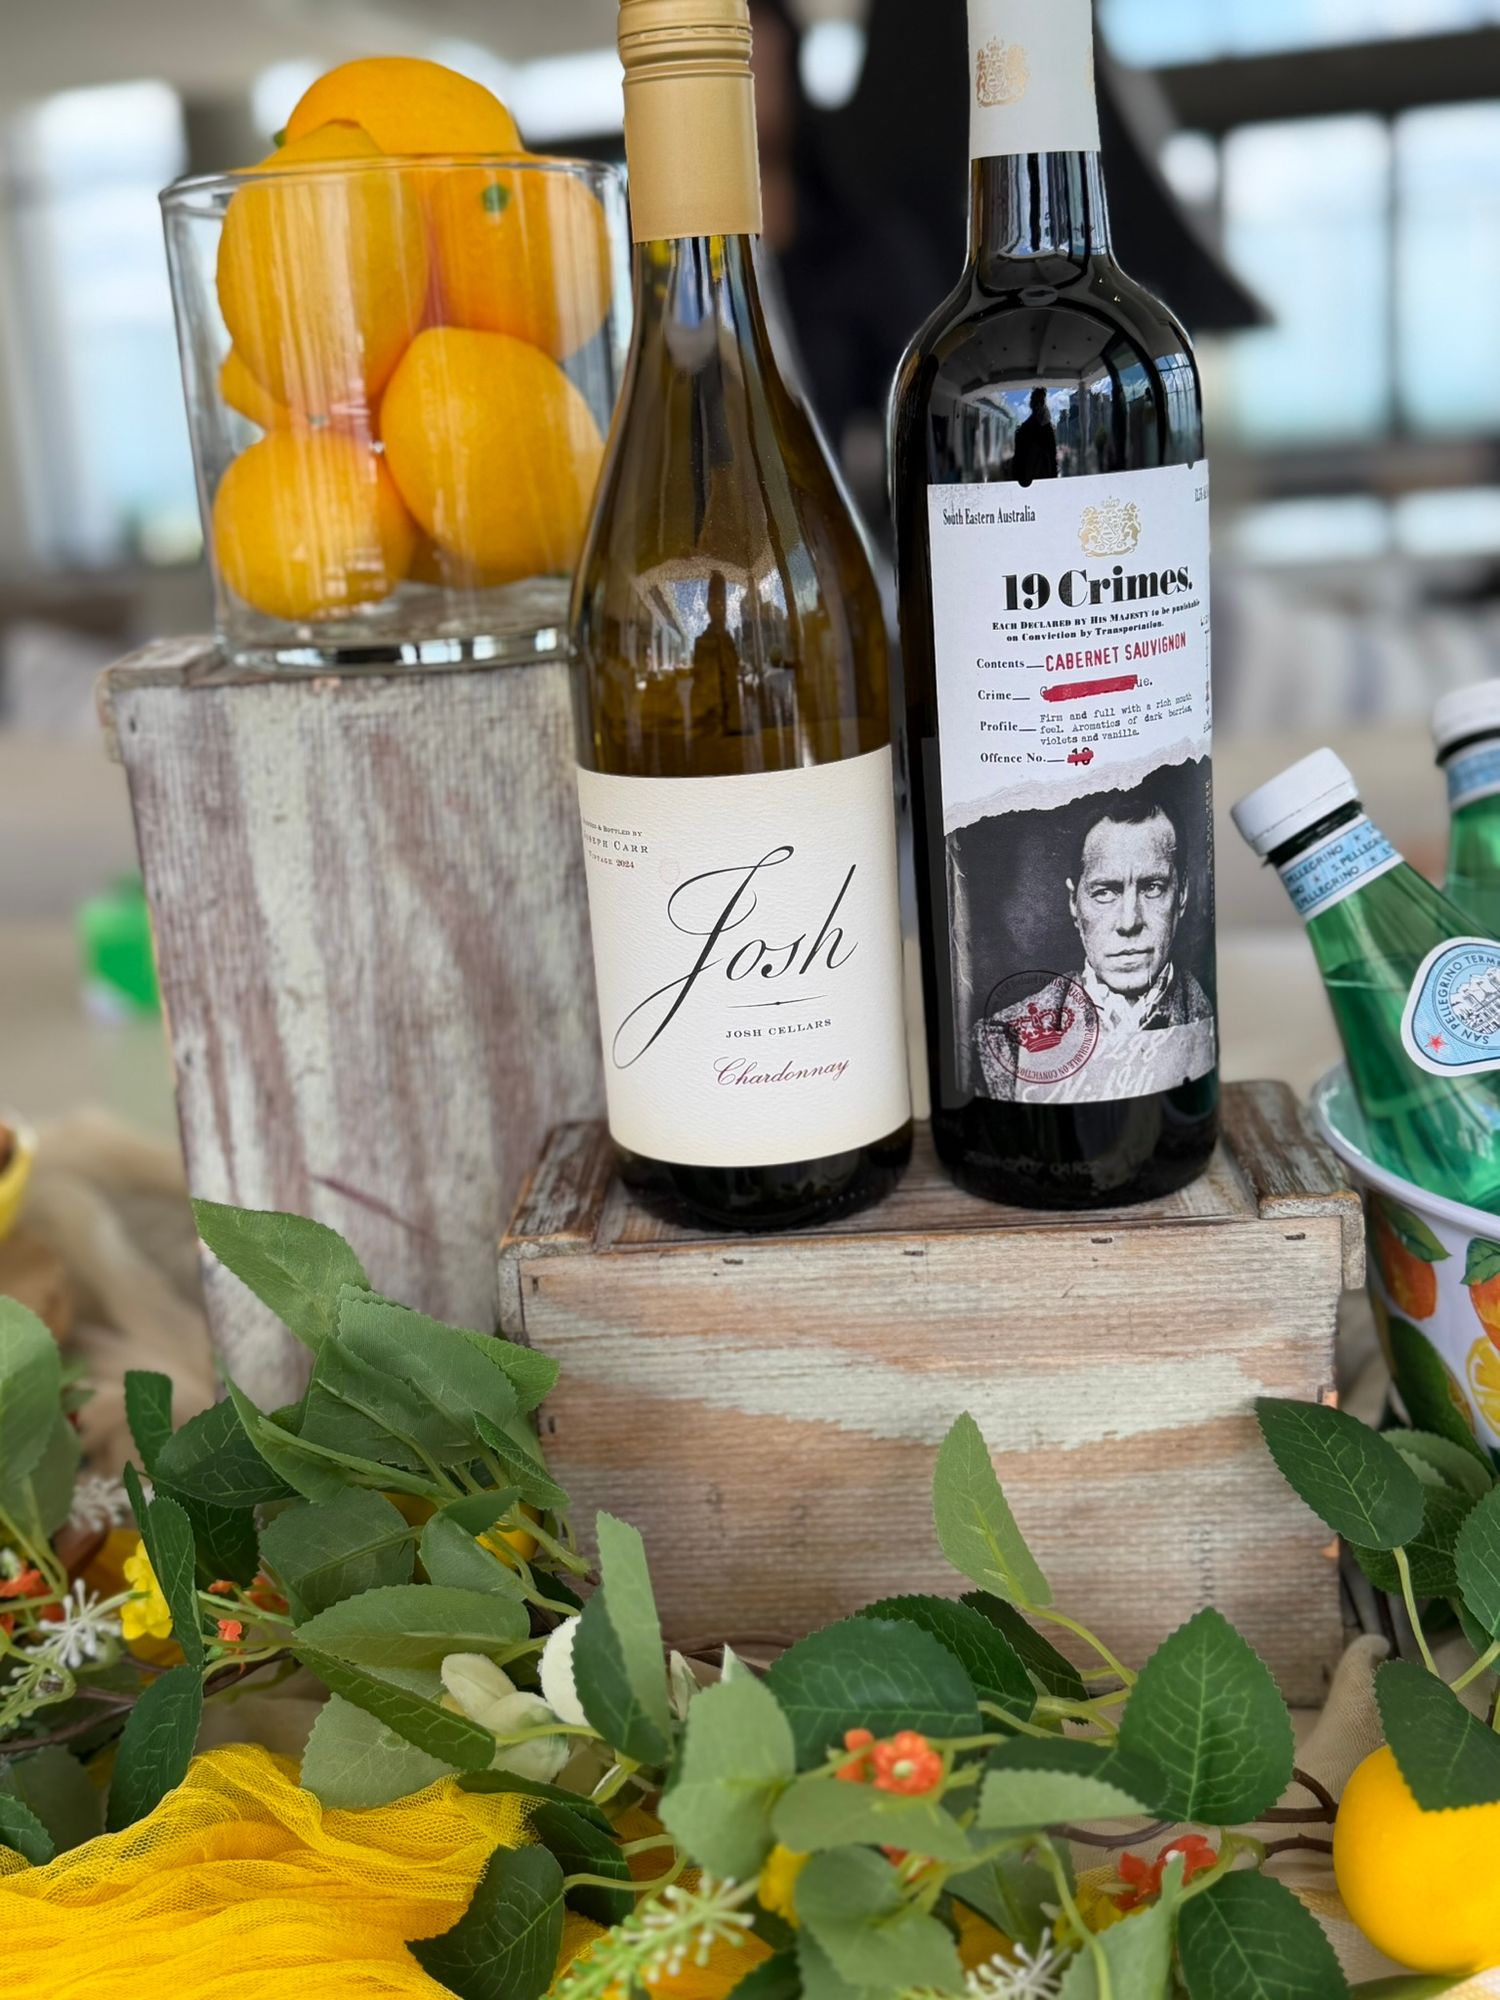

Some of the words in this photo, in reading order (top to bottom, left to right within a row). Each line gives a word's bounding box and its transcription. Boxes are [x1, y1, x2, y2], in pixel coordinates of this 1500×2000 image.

[943, 508, 963, 525] South
[965, 508, 995, 525] Eastern
[998, 505, 1036, 523] Australia
[1002, 573, 1050, 611] 19
[1058, 565, 1193, 608] Crimes.
[1151, 608, 1159, 616] to
[1161, 606, 1170, 615] be
[1022, 630, 1077, 642] Conviction
[1080, 629, 1092, 639] by
[1096, 621, 1164, 637] Transportation.
[977, 659, 1025, 669] Contents
[1045, 646, 1119, 672] CABERNET
[1125, 632, 1186, 662] SAUVIGNON
[978, 689, 1012, 700] Crime
[1040, 713, 1063, 723] Firm
[1070, 710, 1087, 721] and
[1094, 708, 1116, 719] full
[1121, 704, 1141, 715] with
[1156, 698, 1172, 709] rich
[980, 721, 1018, 732] Profile
[1072, 720, 1120, 733] Aromatics
[1128, 717, 1138, 726] of
[1144, 712, 1163, 722] dark
[1040, 735, 1078, 745] violets
[1081, 733, 1099, 742] and
[1102, 729, 1140, 740] vanilla.
[980, 752, 1022, 764] Offence
[1027, 752, 1047, 763] No.
[614, 840, 648, 854] CARR
[616, 859, 634, 869] 2024
[612, 845, 858, 1070] Josh
[1437, 961, 1463, 1030] PELLEGRINO
[726, 1027, 762, 1038] JOSH
[768, 1018, 832, 1036] CELLARS
[1461, 1029, 1490, 1045] SAN
[713, 1056, 851, 1087] Chardonnay
[1016, 1066, 1059, 1081] CONVICTIO
[1059, 1065, 1070, 1077] ON
